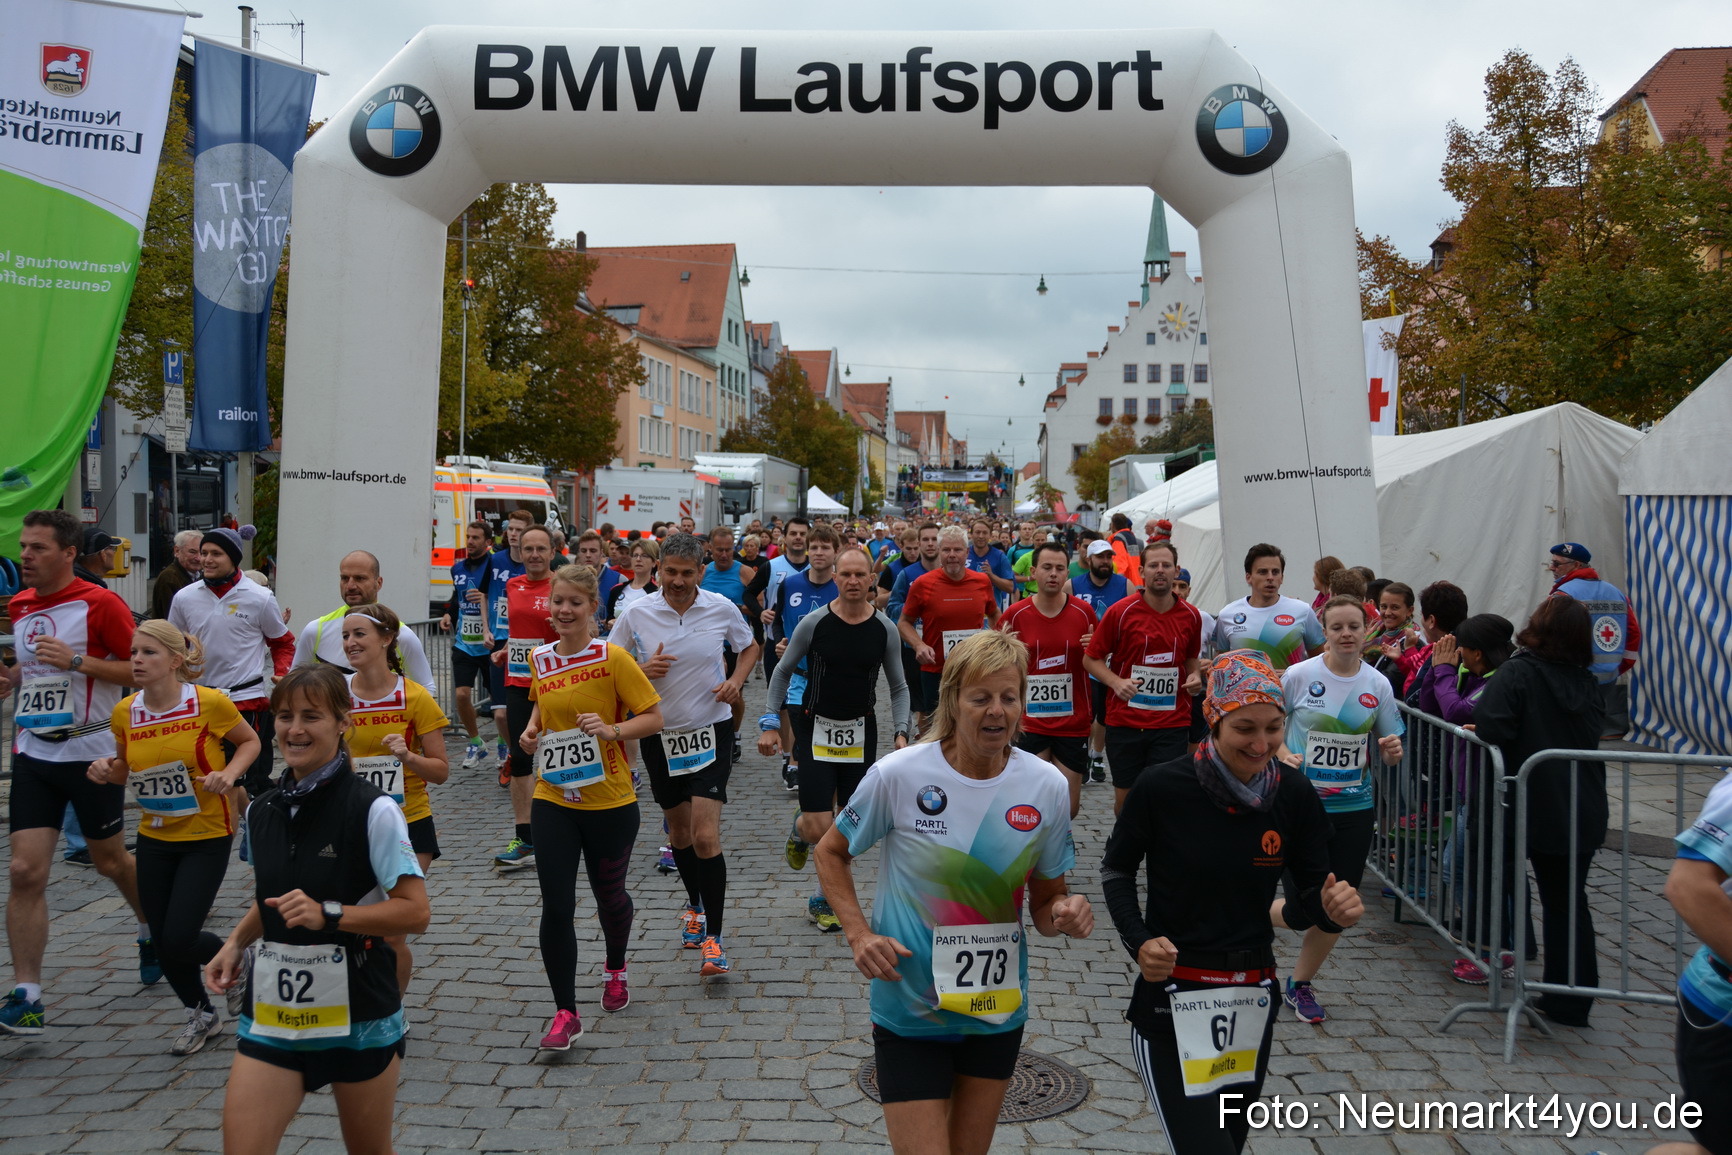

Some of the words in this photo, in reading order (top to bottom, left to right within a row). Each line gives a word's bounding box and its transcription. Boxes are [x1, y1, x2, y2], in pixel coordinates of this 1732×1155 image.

[474, 44, 716, 112] BMW
[740, 46, 1164, 130] Laufsport
[361, 87, 433, 116] BMW
[1204, 85, 1277, 115] BMW
[211, 180, 269, 214] THE
[237, 251, 267, 284] GO
[218, 407, 258, 422] railon
[121, 465, 127, 480] 3
[283, 469, 407, 485] www.bmw-laufsport.de
[1244, 464, 1372, 484] www.bmw-laufsport.de
[493, 568, 510, 582] 14
[776, 571, 788, 585] 7
[789, 592, 803, 607] 6
[35, 681, 61, 689] Neumarkt
[539, 678, 566, 696] MAX
[571, 667, 610, 685] BÖGL
[1136, 677, 1174, 695] 2406
[1030, 684, 1068, 702] 2361
[22, 690, 67, 713] 2467
[1038, 704, 1063, 712] Thomas
[372, 713, 407, 725] BÖGL
[130, 729, 157, 741] MAX
[162, 721, 201, 737] BÖGL
[556, 733, 586, 744] Neumarkt
[825, 729, 854, 746] 163
[668, 731, 711, 756] 2046
[1309, 735, 1329, 744] PARTL
[1332, 738, 1360, 746] Neumarkt
[544, 741, 595, 770] 2735
[1312, 745, 1360, 768] 2051
[144, 767, 175, 777] Neumarkt
[560, 770, 584, 782] Sarah
[132, 775, 187, 796] 2738
[157, 801, 174, 810] Lisa
[915, 819, 948, 830] PARTL
[1011, 810, 1037, 825] Hervis
[915, 828, 948, 836] Neumarkt
[936, 935, 968, 945] PARTL
[972, 933, 1009, 944] Neumarkt
[258, 949, 280, 962] PARTL
[281, 954, 327, 965] Neumarkt
[956, 948, 1008, 988] 273
[278, 968, 315, 1004] 62
[970, 996, 997, 1012] Heidi
[1175, 1000, 1211, 1012] PARTL
[1214, 998, 1254, 1009] Neumarkt
[277, 1010, 319, 1027] Kerstin
[1211, 1011, 1237, 1052] 61
